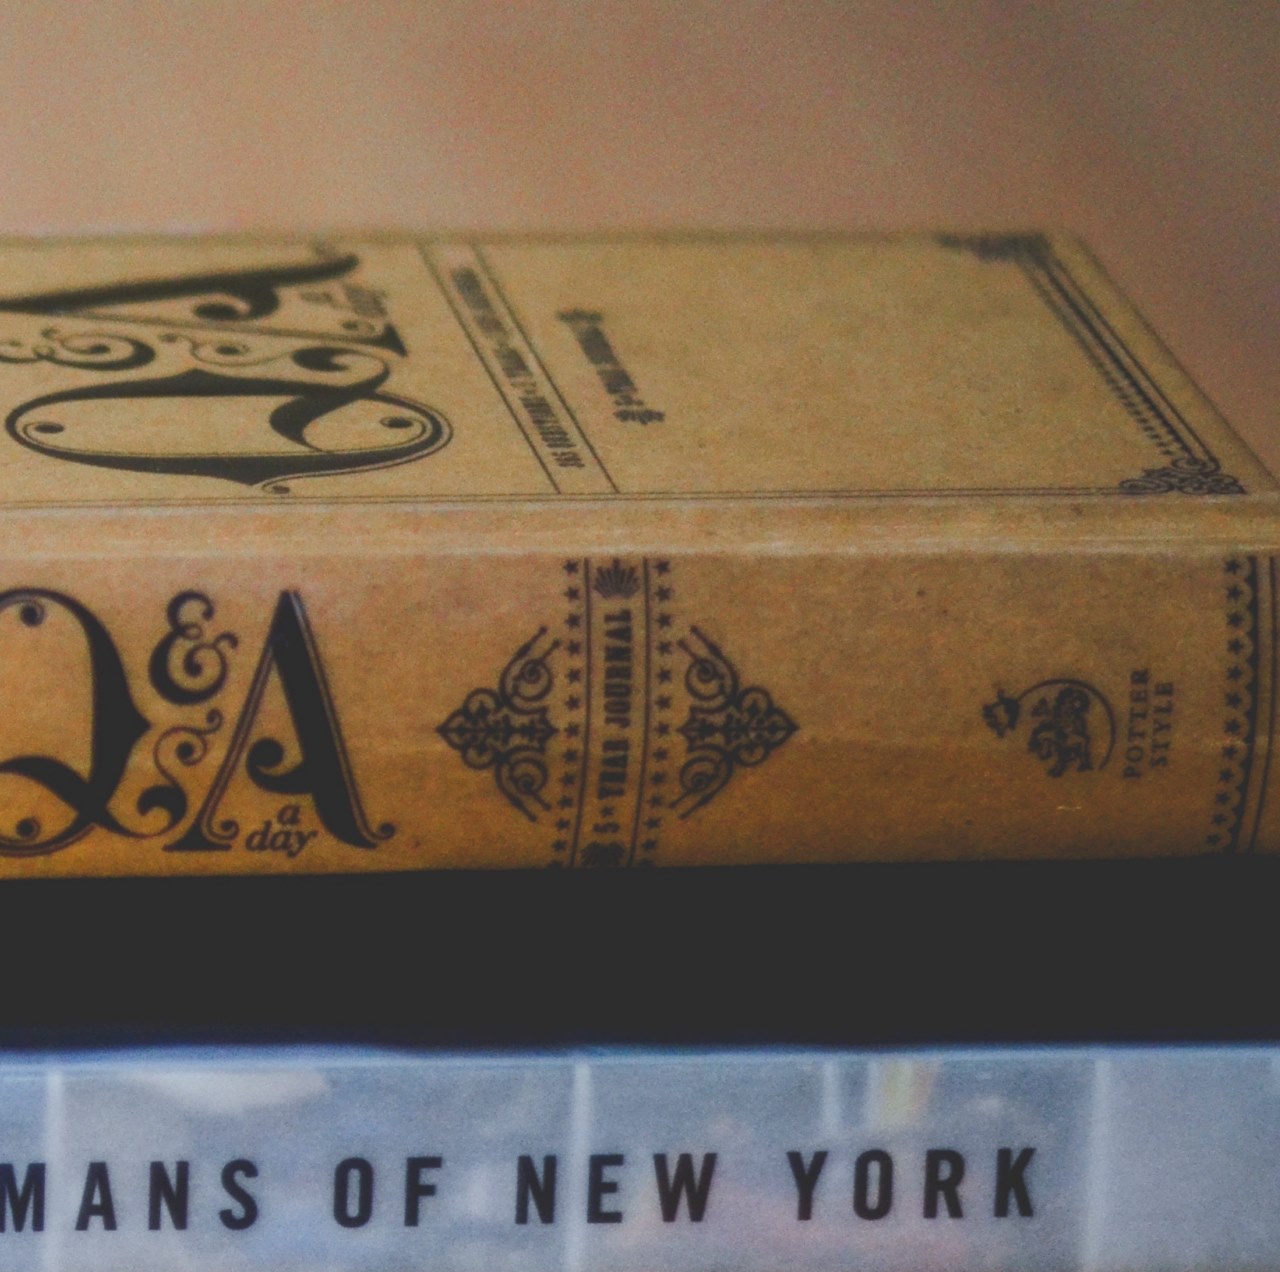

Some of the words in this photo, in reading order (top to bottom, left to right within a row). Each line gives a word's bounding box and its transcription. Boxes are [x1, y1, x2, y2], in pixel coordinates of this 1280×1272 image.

[603, 609, 634, 729] JOURNAL
[1124, 669, 1149, 779] POTTER
[1151, 682, 1174, 767] STYLE
[597, 739, 630, 801] YEAR
[244, 826, 318, 858] day
[277, 806, 300, 825] a
[333, 1155, 444, 1229] OF
[515, 1152, 718, 1225] NEW
[786, 1146, 1037, 1221] YORK
